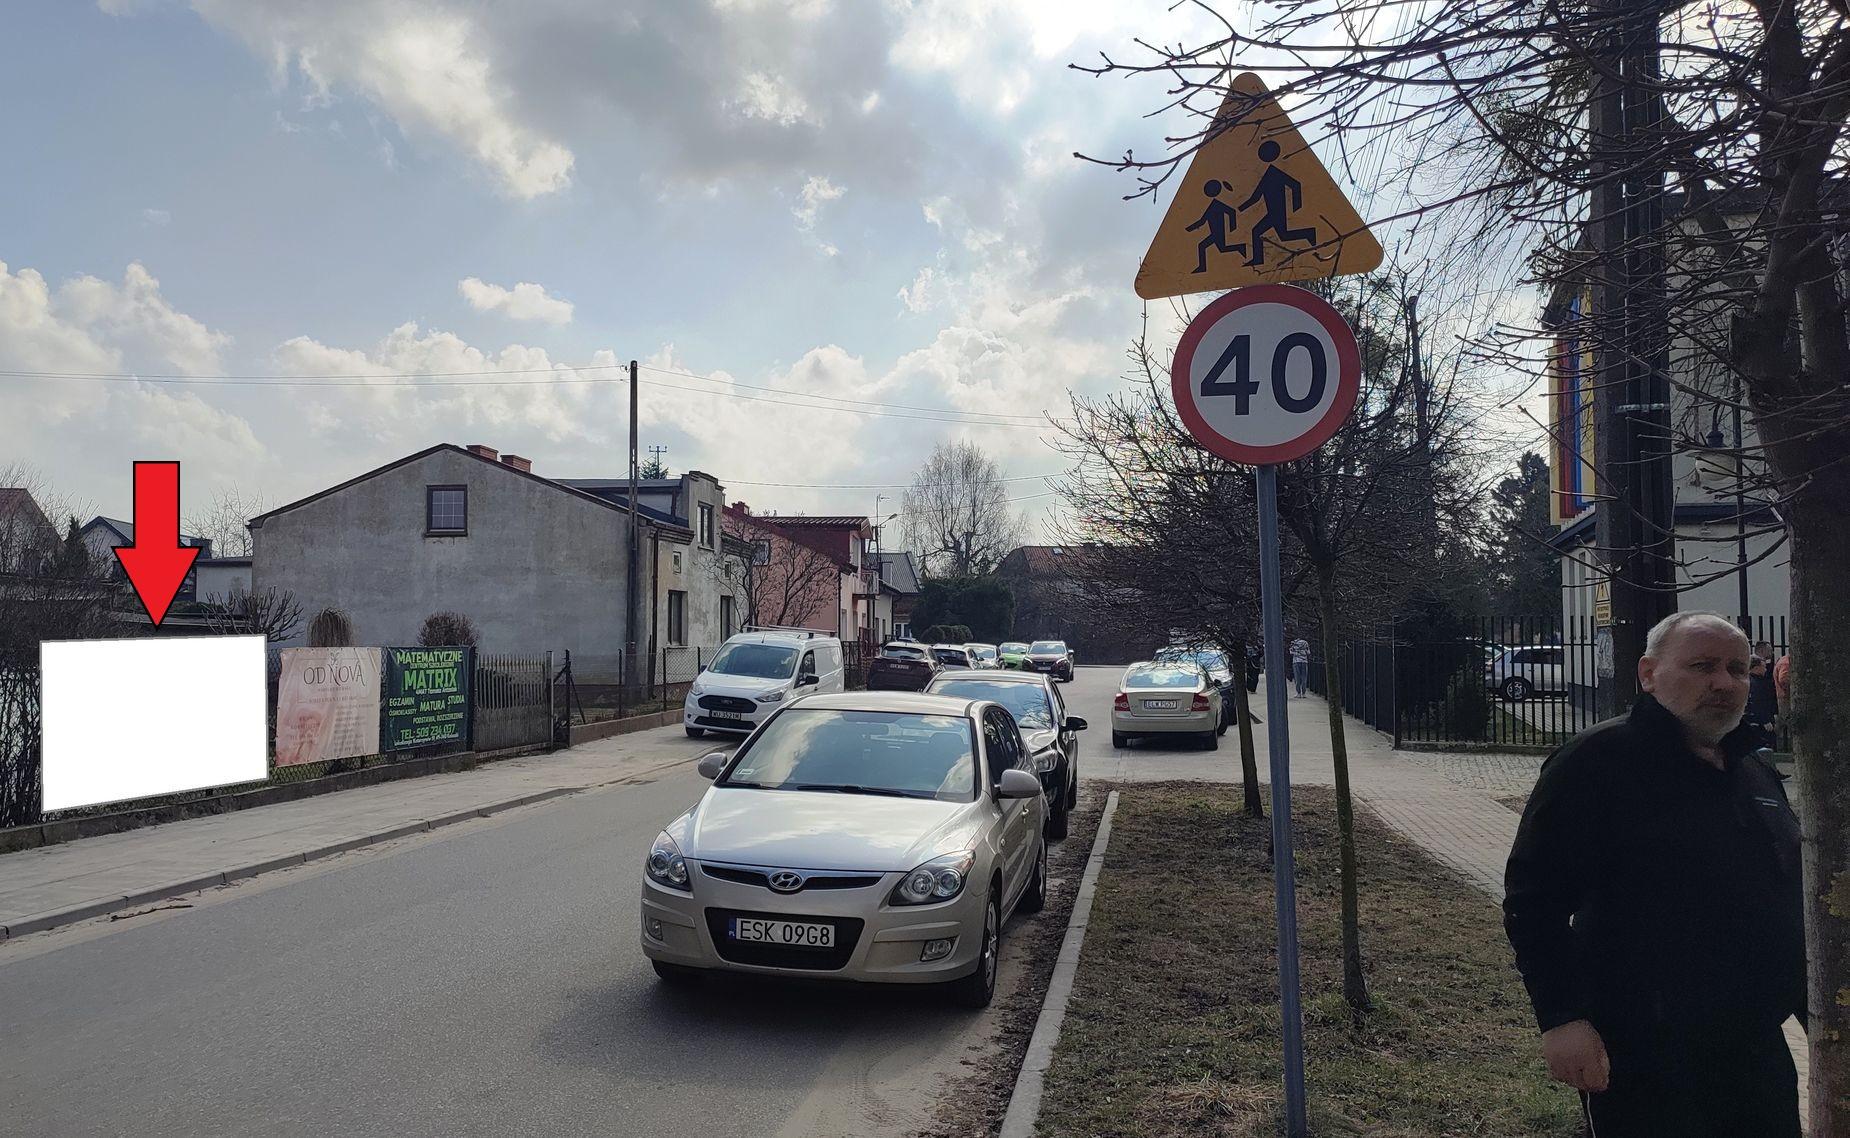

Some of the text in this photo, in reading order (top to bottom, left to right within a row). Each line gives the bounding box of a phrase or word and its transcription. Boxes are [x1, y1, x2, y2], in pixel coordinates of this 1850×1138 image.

[1200, 332, 1328, 416] 40
[396, 651, 463, 664] MATEMATYCZNE
[404, 668, 457, 690] MATRIX
[389, 697, 415, 707] EGZAMIN
[420, 700, 445, 712] MATURA
[447, 695, 465, 705] STUDIA
[740, 920, 775, 941] ESK
[783, 924, 830, 946] 09G8
